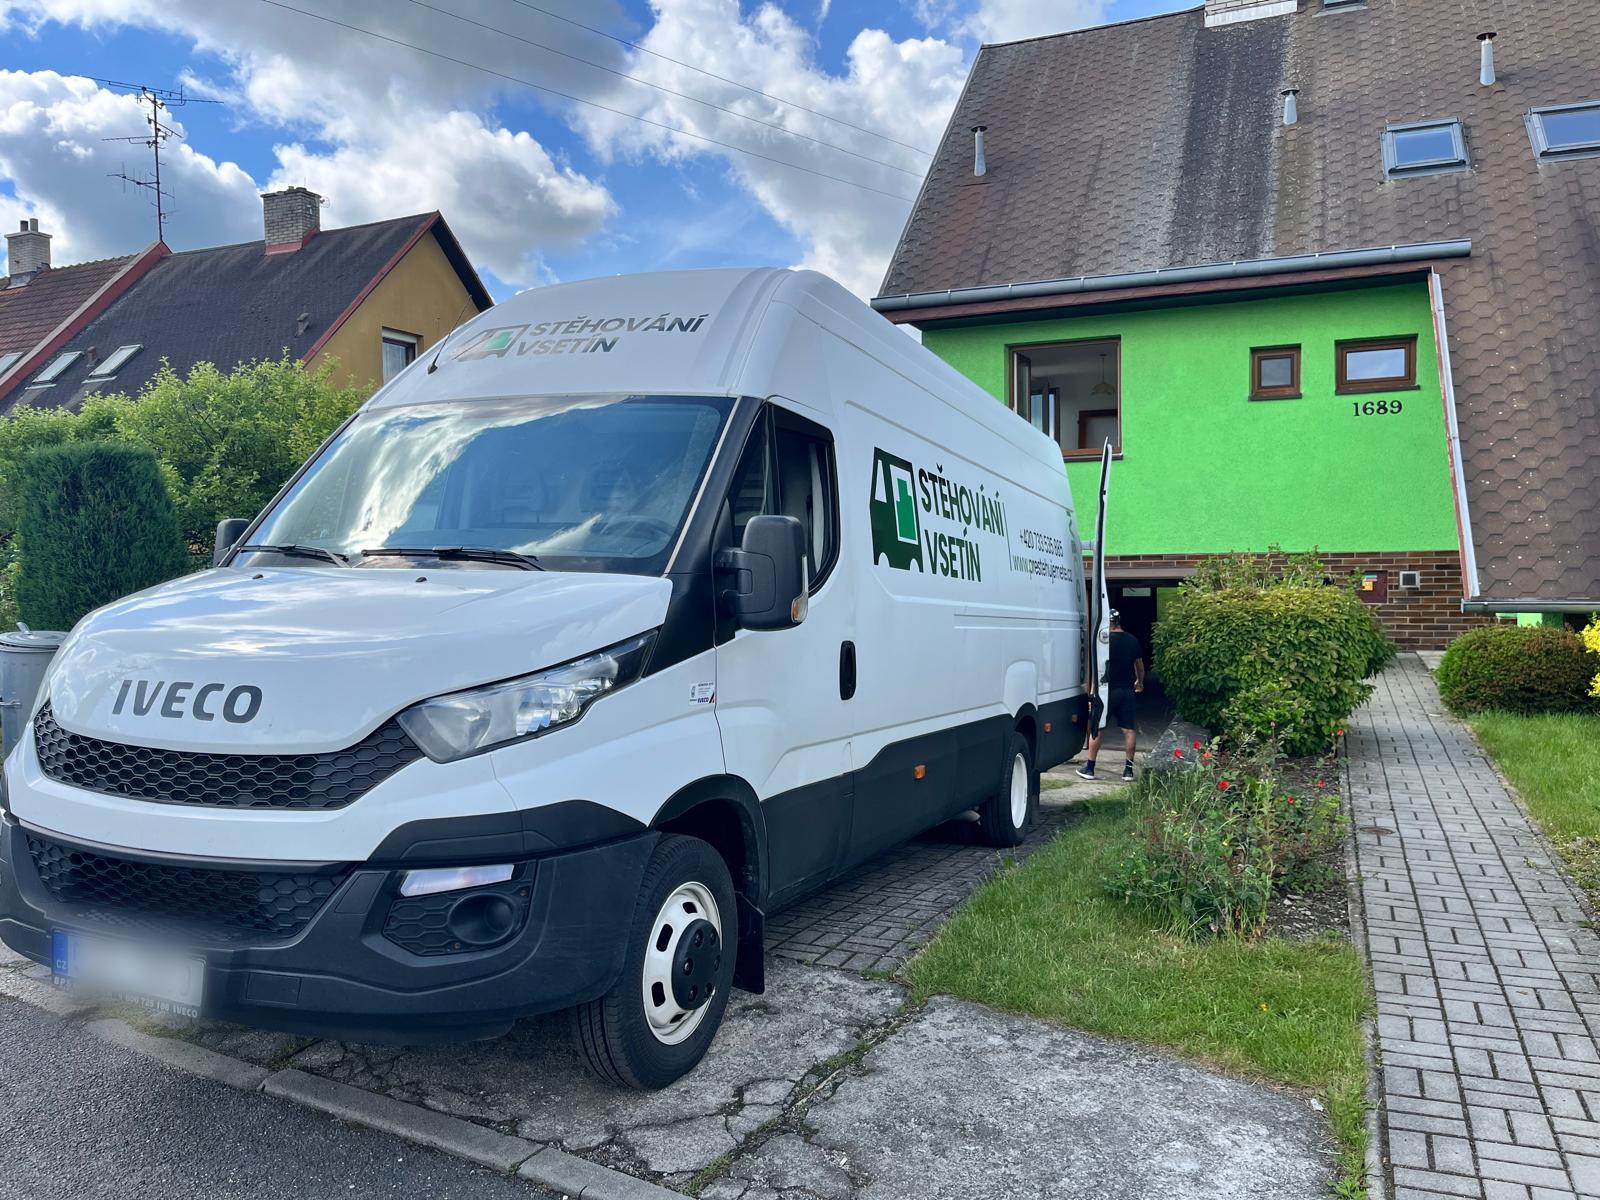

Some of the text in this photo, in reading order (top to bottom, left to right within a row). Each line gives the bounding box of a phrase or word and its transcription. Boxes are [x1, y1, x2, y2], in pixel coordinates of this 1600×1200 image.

[529, 312, 710, 337] STĚHOVÁNÍ
[516, 333, 620, 356] VSETÍN
[1352, 400, 1403, 416] 1689
[918, 462, 1005, 537] STĚHOVÁNÍ
[923, 527, 982, 583] VSETÍN
[111, 679, 263, 724] IVECO
[56, 959, 67, 970] CZ
[172, 1004, 198, 1018] IVECO
